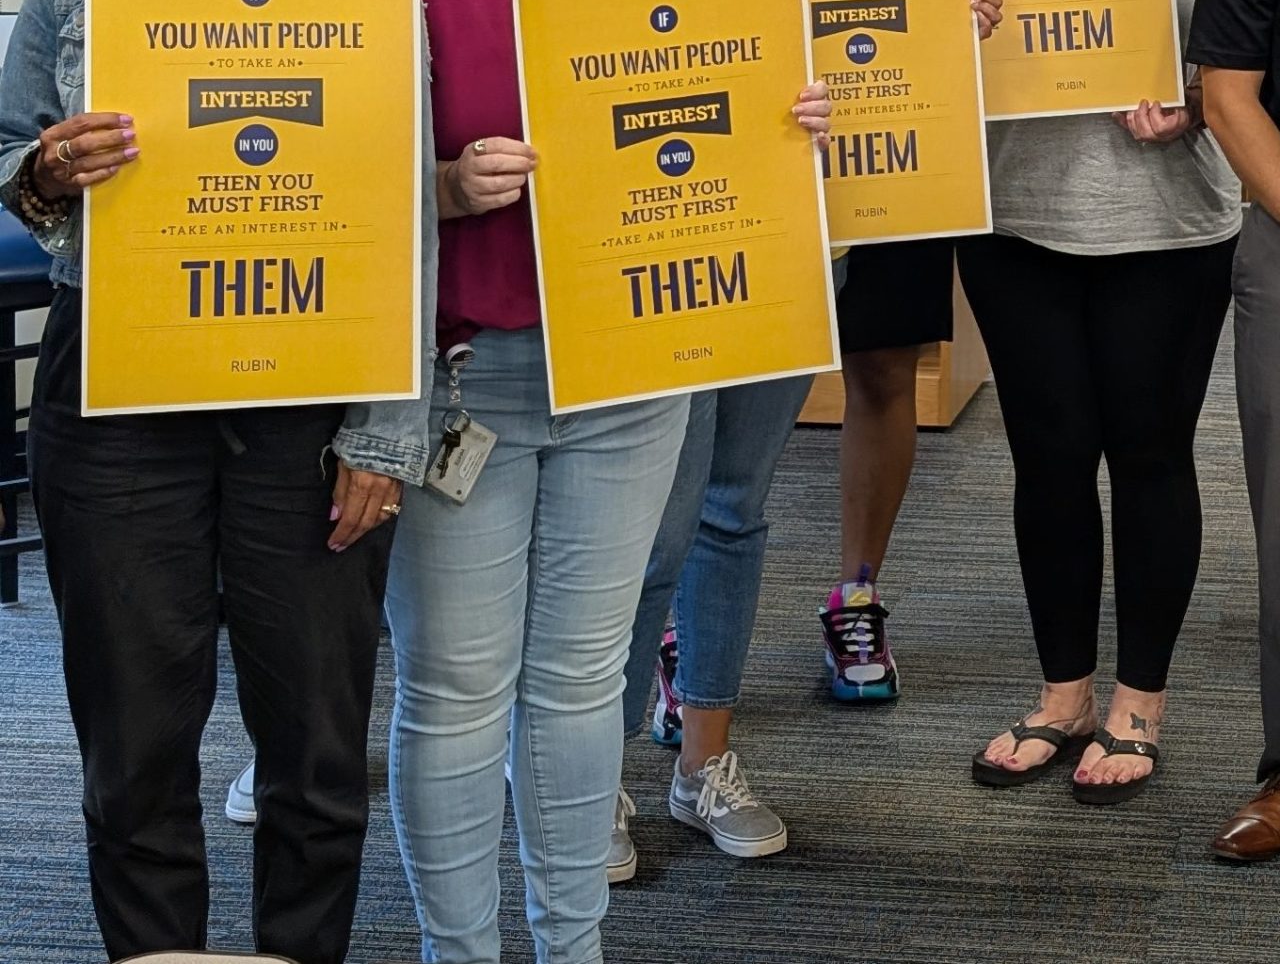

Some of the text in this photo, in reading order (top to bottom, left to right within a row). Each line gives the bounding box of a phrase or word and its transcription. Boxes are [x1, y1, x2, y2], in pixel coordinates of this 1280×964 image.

[659, 12, 670, 27] IF
[820, 7, 898, 24] INTEREST
[145, 22, 363, 49] YOU WANT PEOPLE
[1017, 8, 1113, 53] THEM
[849, 44, 873, 54] IN YOU
[216, 58, 296, 68] TO TAKE AN
[570, 37, 762, 81] YOU WANT PEOPLE
[635, 76, 704, 92] TO TAKE AN
[822, 69, 903, 86] THEN YOU
[1057, 81, 1086, 90] RUBIN
[200, 90, 312, 108] INTEREST
[866, 84, 911, 98] FIRST
[623, 103, 720, 130] INTEREST
[836, 103, 924, 116] AN INTEREST IN
[239, 139, 273, 151] IN YOU
[661, 150, 690, 165] IN YOU
[198, 174, 313, 192] THEN YOU
[629, 178, 727, 205] THEN YOU
[187, 194, 322, 213] MUST FIRST
[621, 196, 738, 226] MUST FIRST
[855, 207, 887, 218] RUBIN
[168, 222, 338, 235] TAKE AN INTEREST IN
[607, 218, 754, 248] TAKE AN INTEREST IN
[181, 257, 324, 317] THEM
[621, 251, 749, 318] THEM
[674, 347, 713, 362] RUBIN
[231, 359, 276, 372] RUBIN
